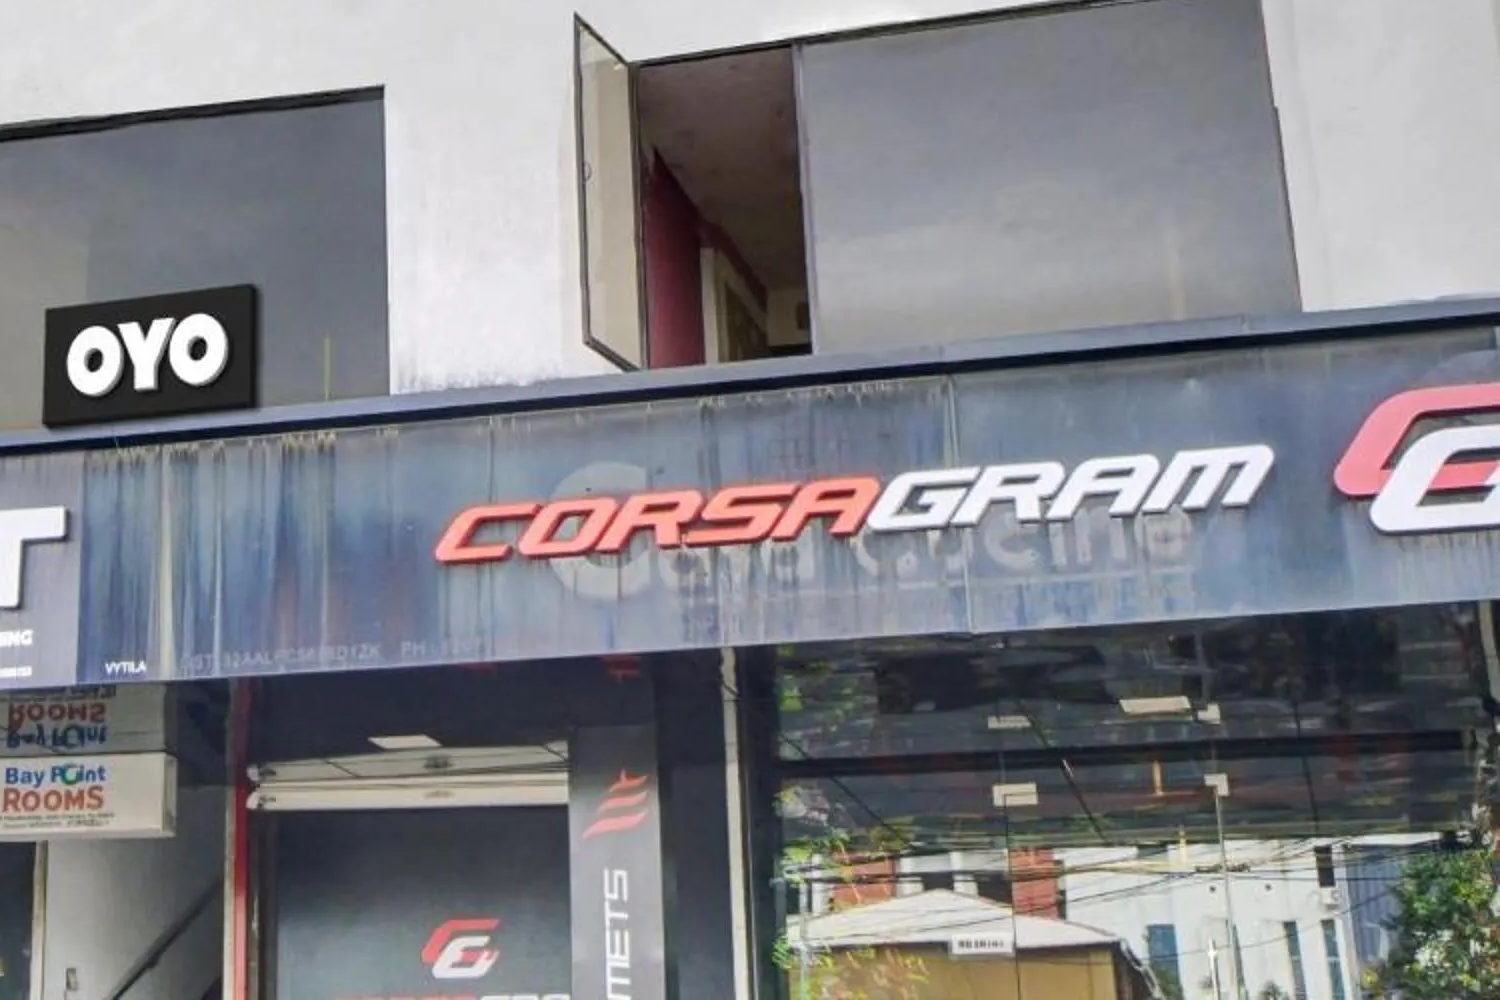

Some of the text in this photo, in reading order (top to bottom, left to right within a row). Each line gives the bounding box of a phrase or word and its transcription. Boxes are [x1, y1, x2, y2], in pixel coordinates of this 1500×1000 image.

[66, 313, 228, 396] OYO
[434, 442, 1275, 563] CORSAGRAM
[105, 660, 147, 675] VYTILA
[5, 763, 106, 788] Bay Point
[2, 786, 104, 813] ROOMS
